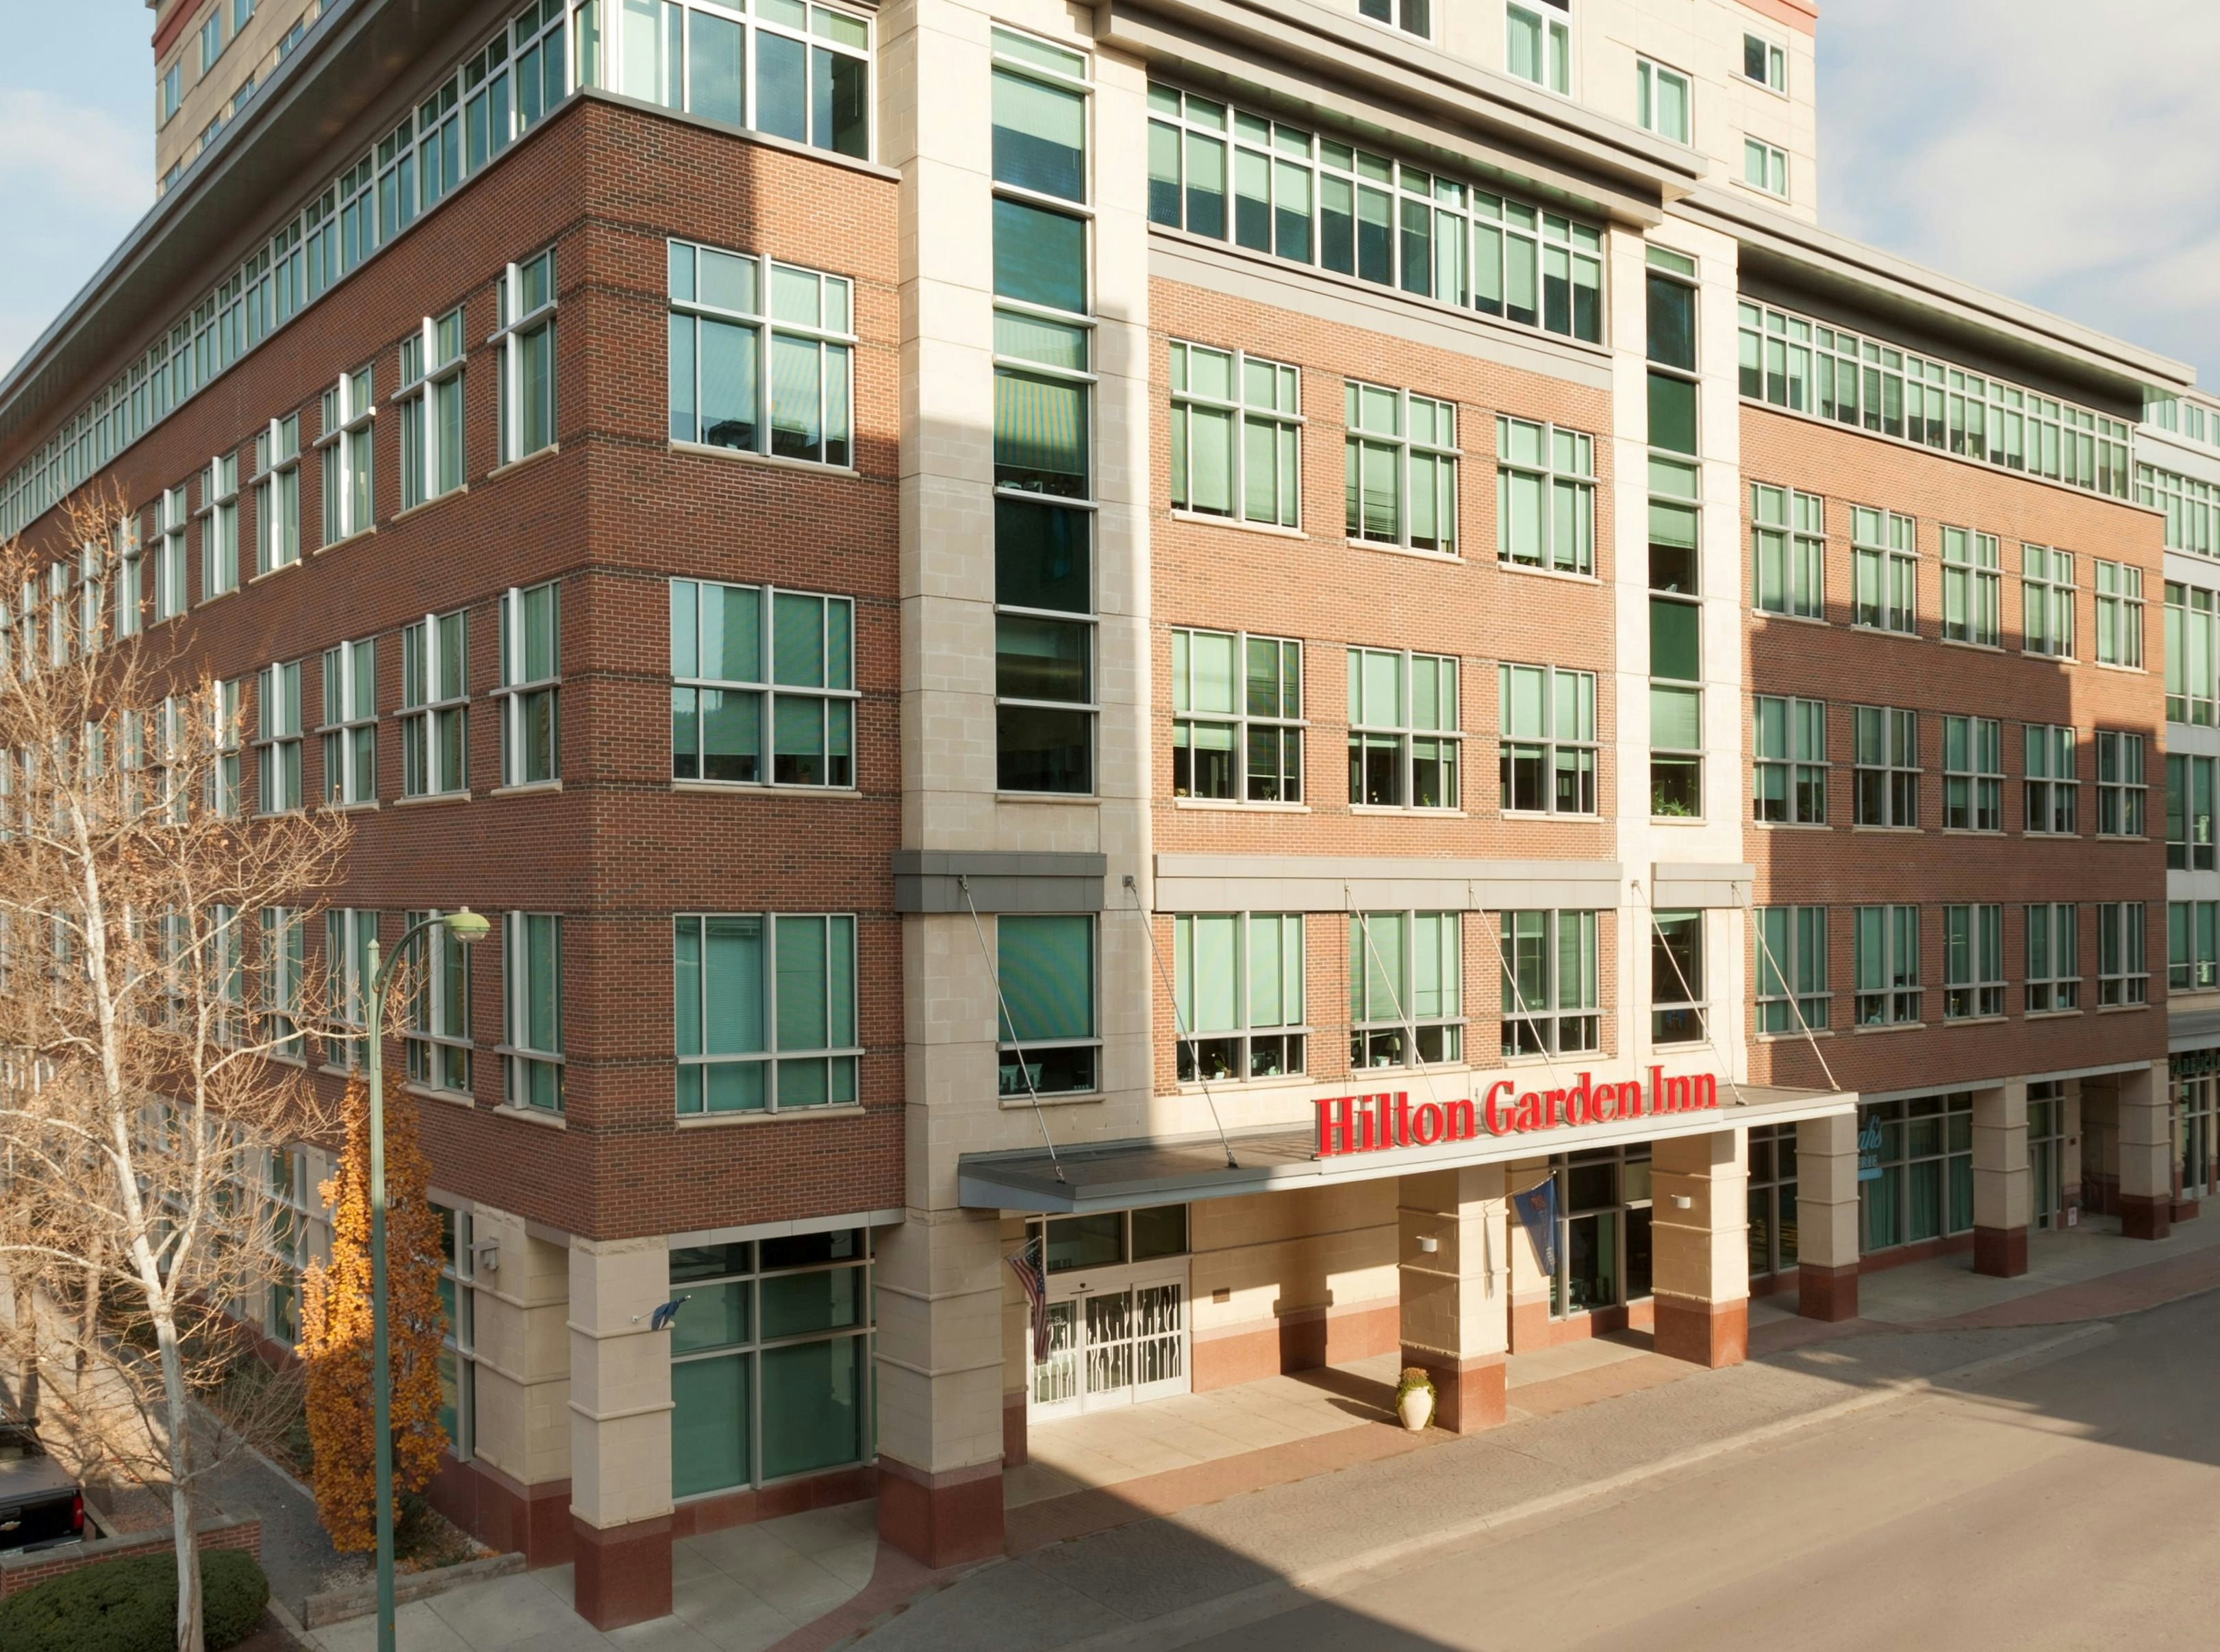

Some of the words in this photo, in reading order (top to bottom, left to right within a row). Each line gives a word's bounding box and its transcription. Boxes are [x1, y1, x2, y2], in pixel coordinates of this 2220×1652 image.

[1313, 1091, 1478, 1158] Hilton
[1482, 1071, 1645, 1136] Garden
[1648, 1065, 1719, 1115] Inn
